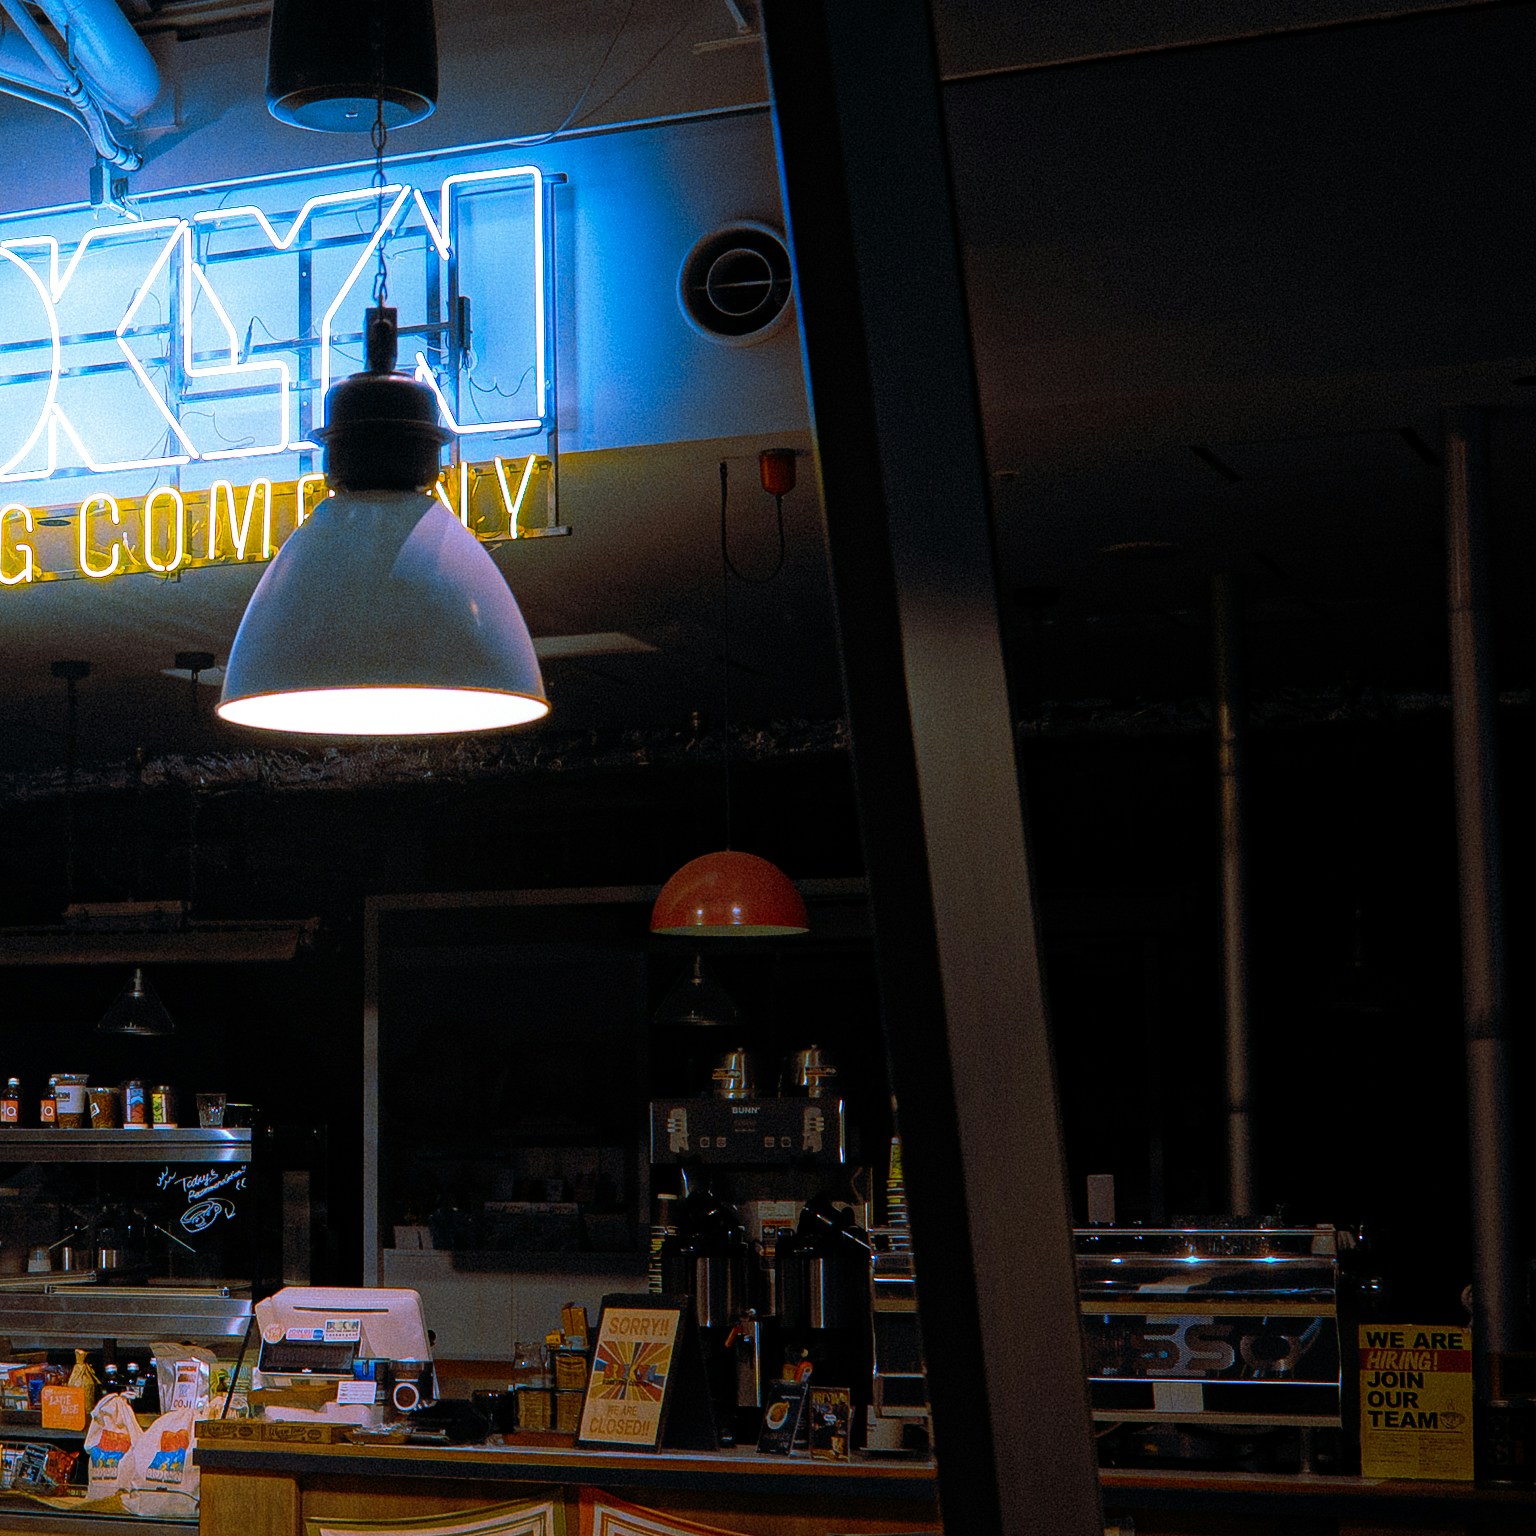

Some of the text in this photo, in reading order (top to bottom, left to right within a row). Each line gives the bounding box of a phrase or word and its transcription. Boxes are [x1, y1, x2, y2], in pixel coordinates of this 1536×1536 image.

[609, 1317, 670, 1337] SORRY!!
[1367, 1332, 1464, 1350] WE ARE
[1366, 1351, 1439, 1371] HIRING!
[1367, 1371, 1424, 1389] JOIN
[1367, 1391, 1419, 1409] OUR
[622, 1405, 637, 1415] ARE
[590, 1418, 651, 1437] CLOSED!!
[1368, 1410, 1439, 1430] TEAM
